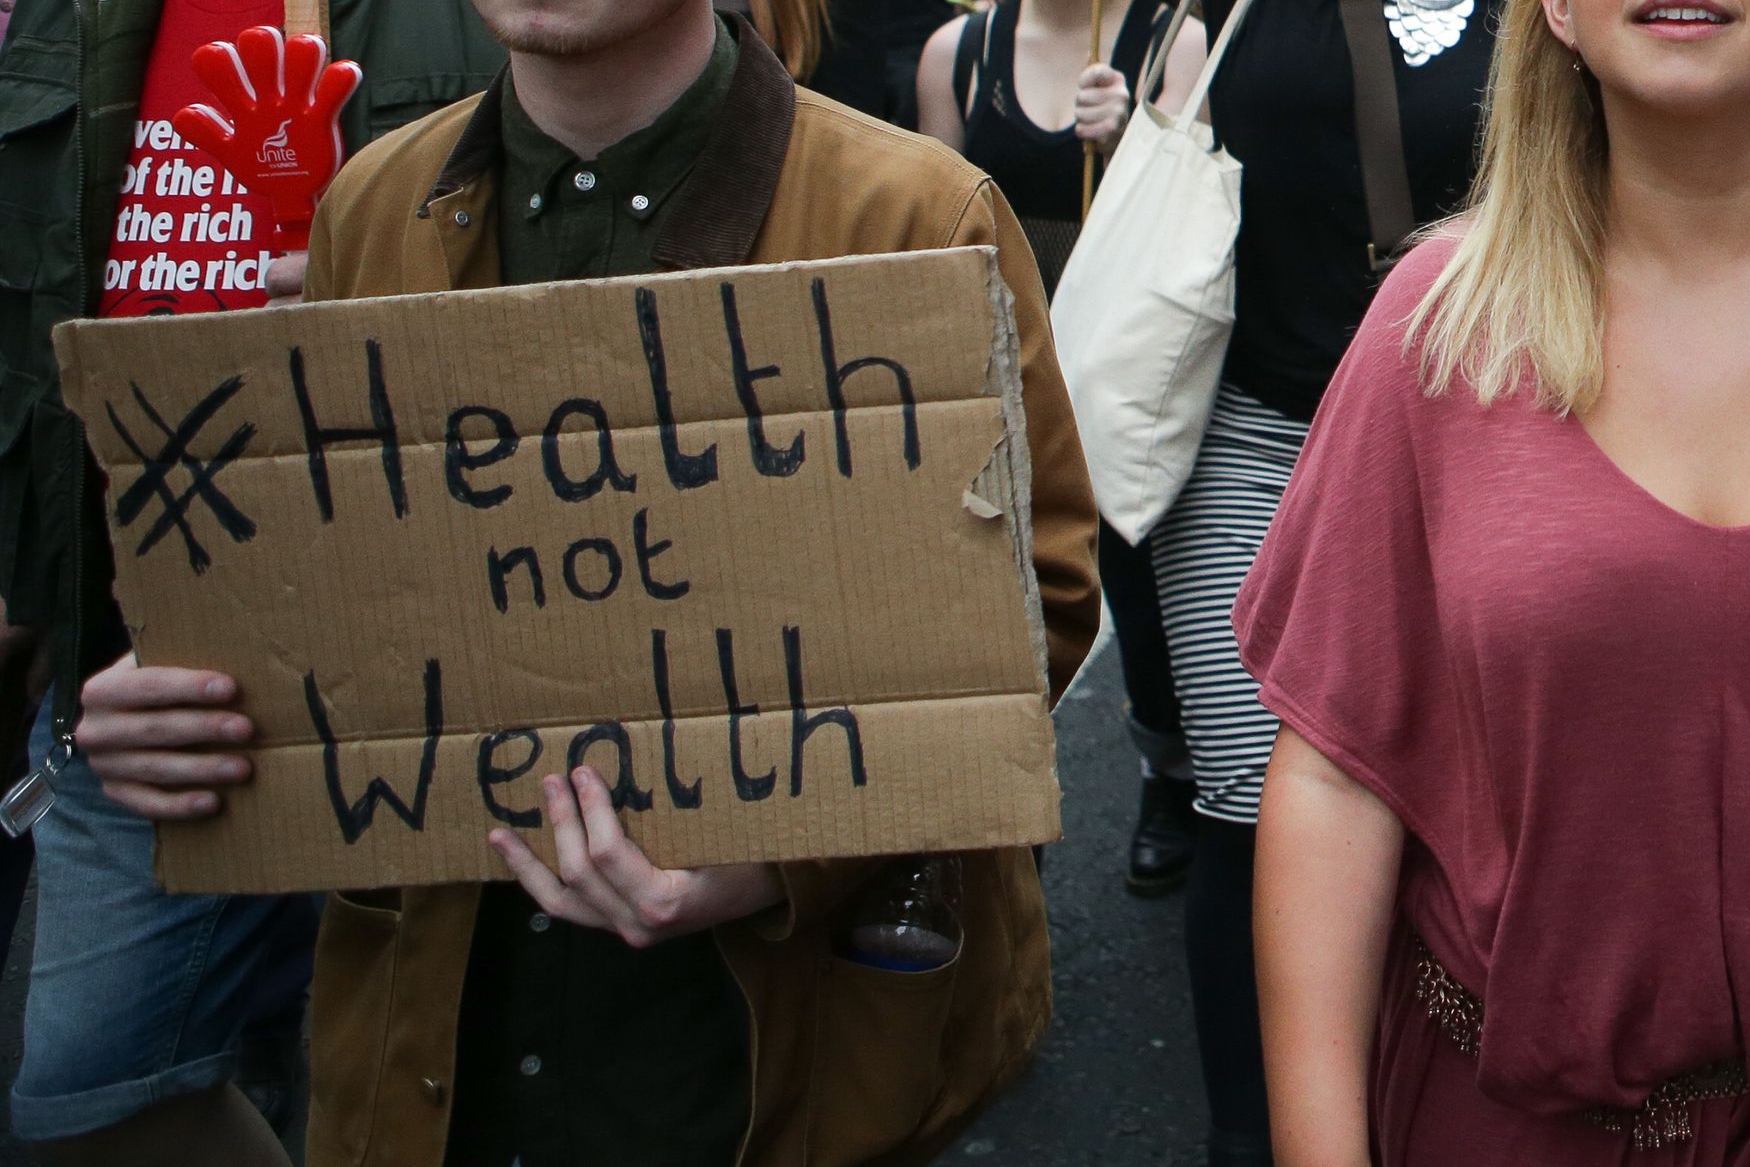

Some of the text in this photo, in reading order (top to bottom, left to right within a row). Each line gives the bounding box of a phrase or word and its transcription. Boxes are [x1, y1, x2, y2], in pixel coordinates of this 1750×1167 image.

[156, 159, 215, 196] the
[117, 203, 252, 243] the rich
[104, 259, 137, 290] or
[139, 252, 200, 291] the
[487, 508, 690, 613] not
[303, 625, 867, 843] Wealth
